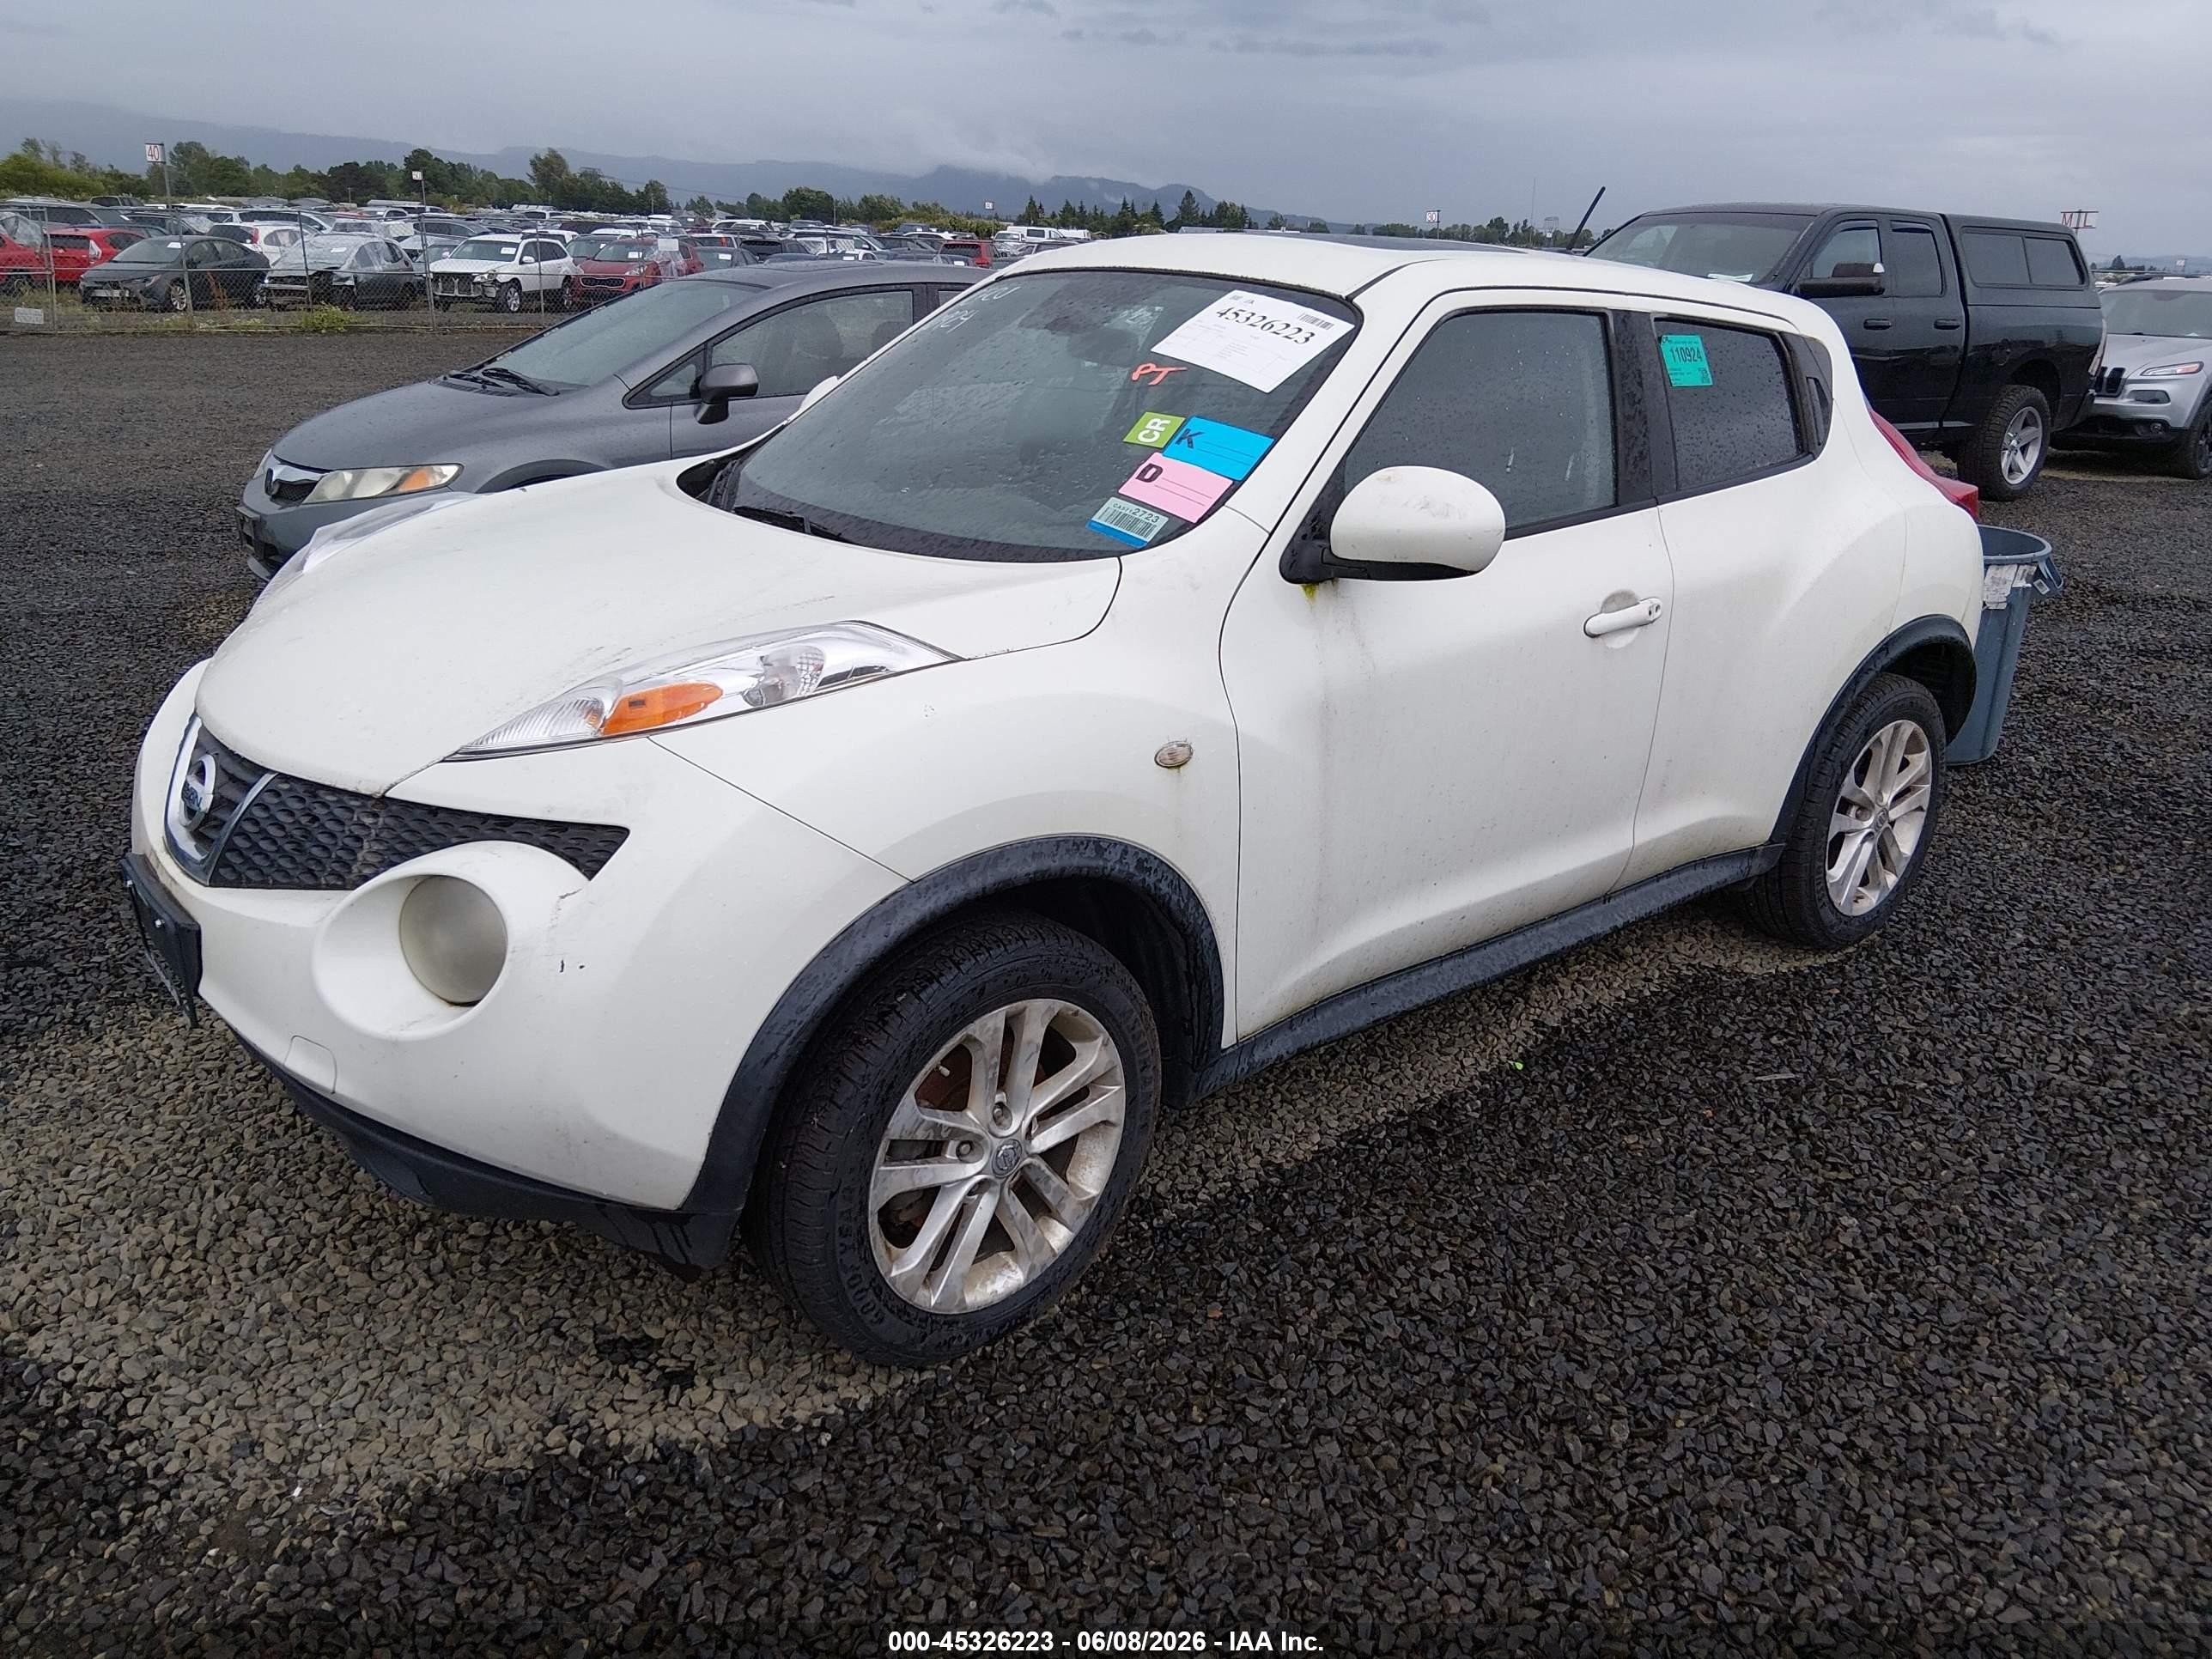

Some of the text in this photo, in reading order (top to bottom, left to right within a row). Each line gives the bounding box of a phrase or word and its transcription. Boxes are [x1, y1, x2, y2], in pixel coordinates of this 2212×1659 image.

[147, 145, 160, 161] 40
[1216, 307, 1316, 344] 45326223
[1669, 346, 1703, 363] 110924
[1138, 417, 1171, 443] CR
[1175, 428, 1206, 449] K
[1135, 463, 1164, 483] D
